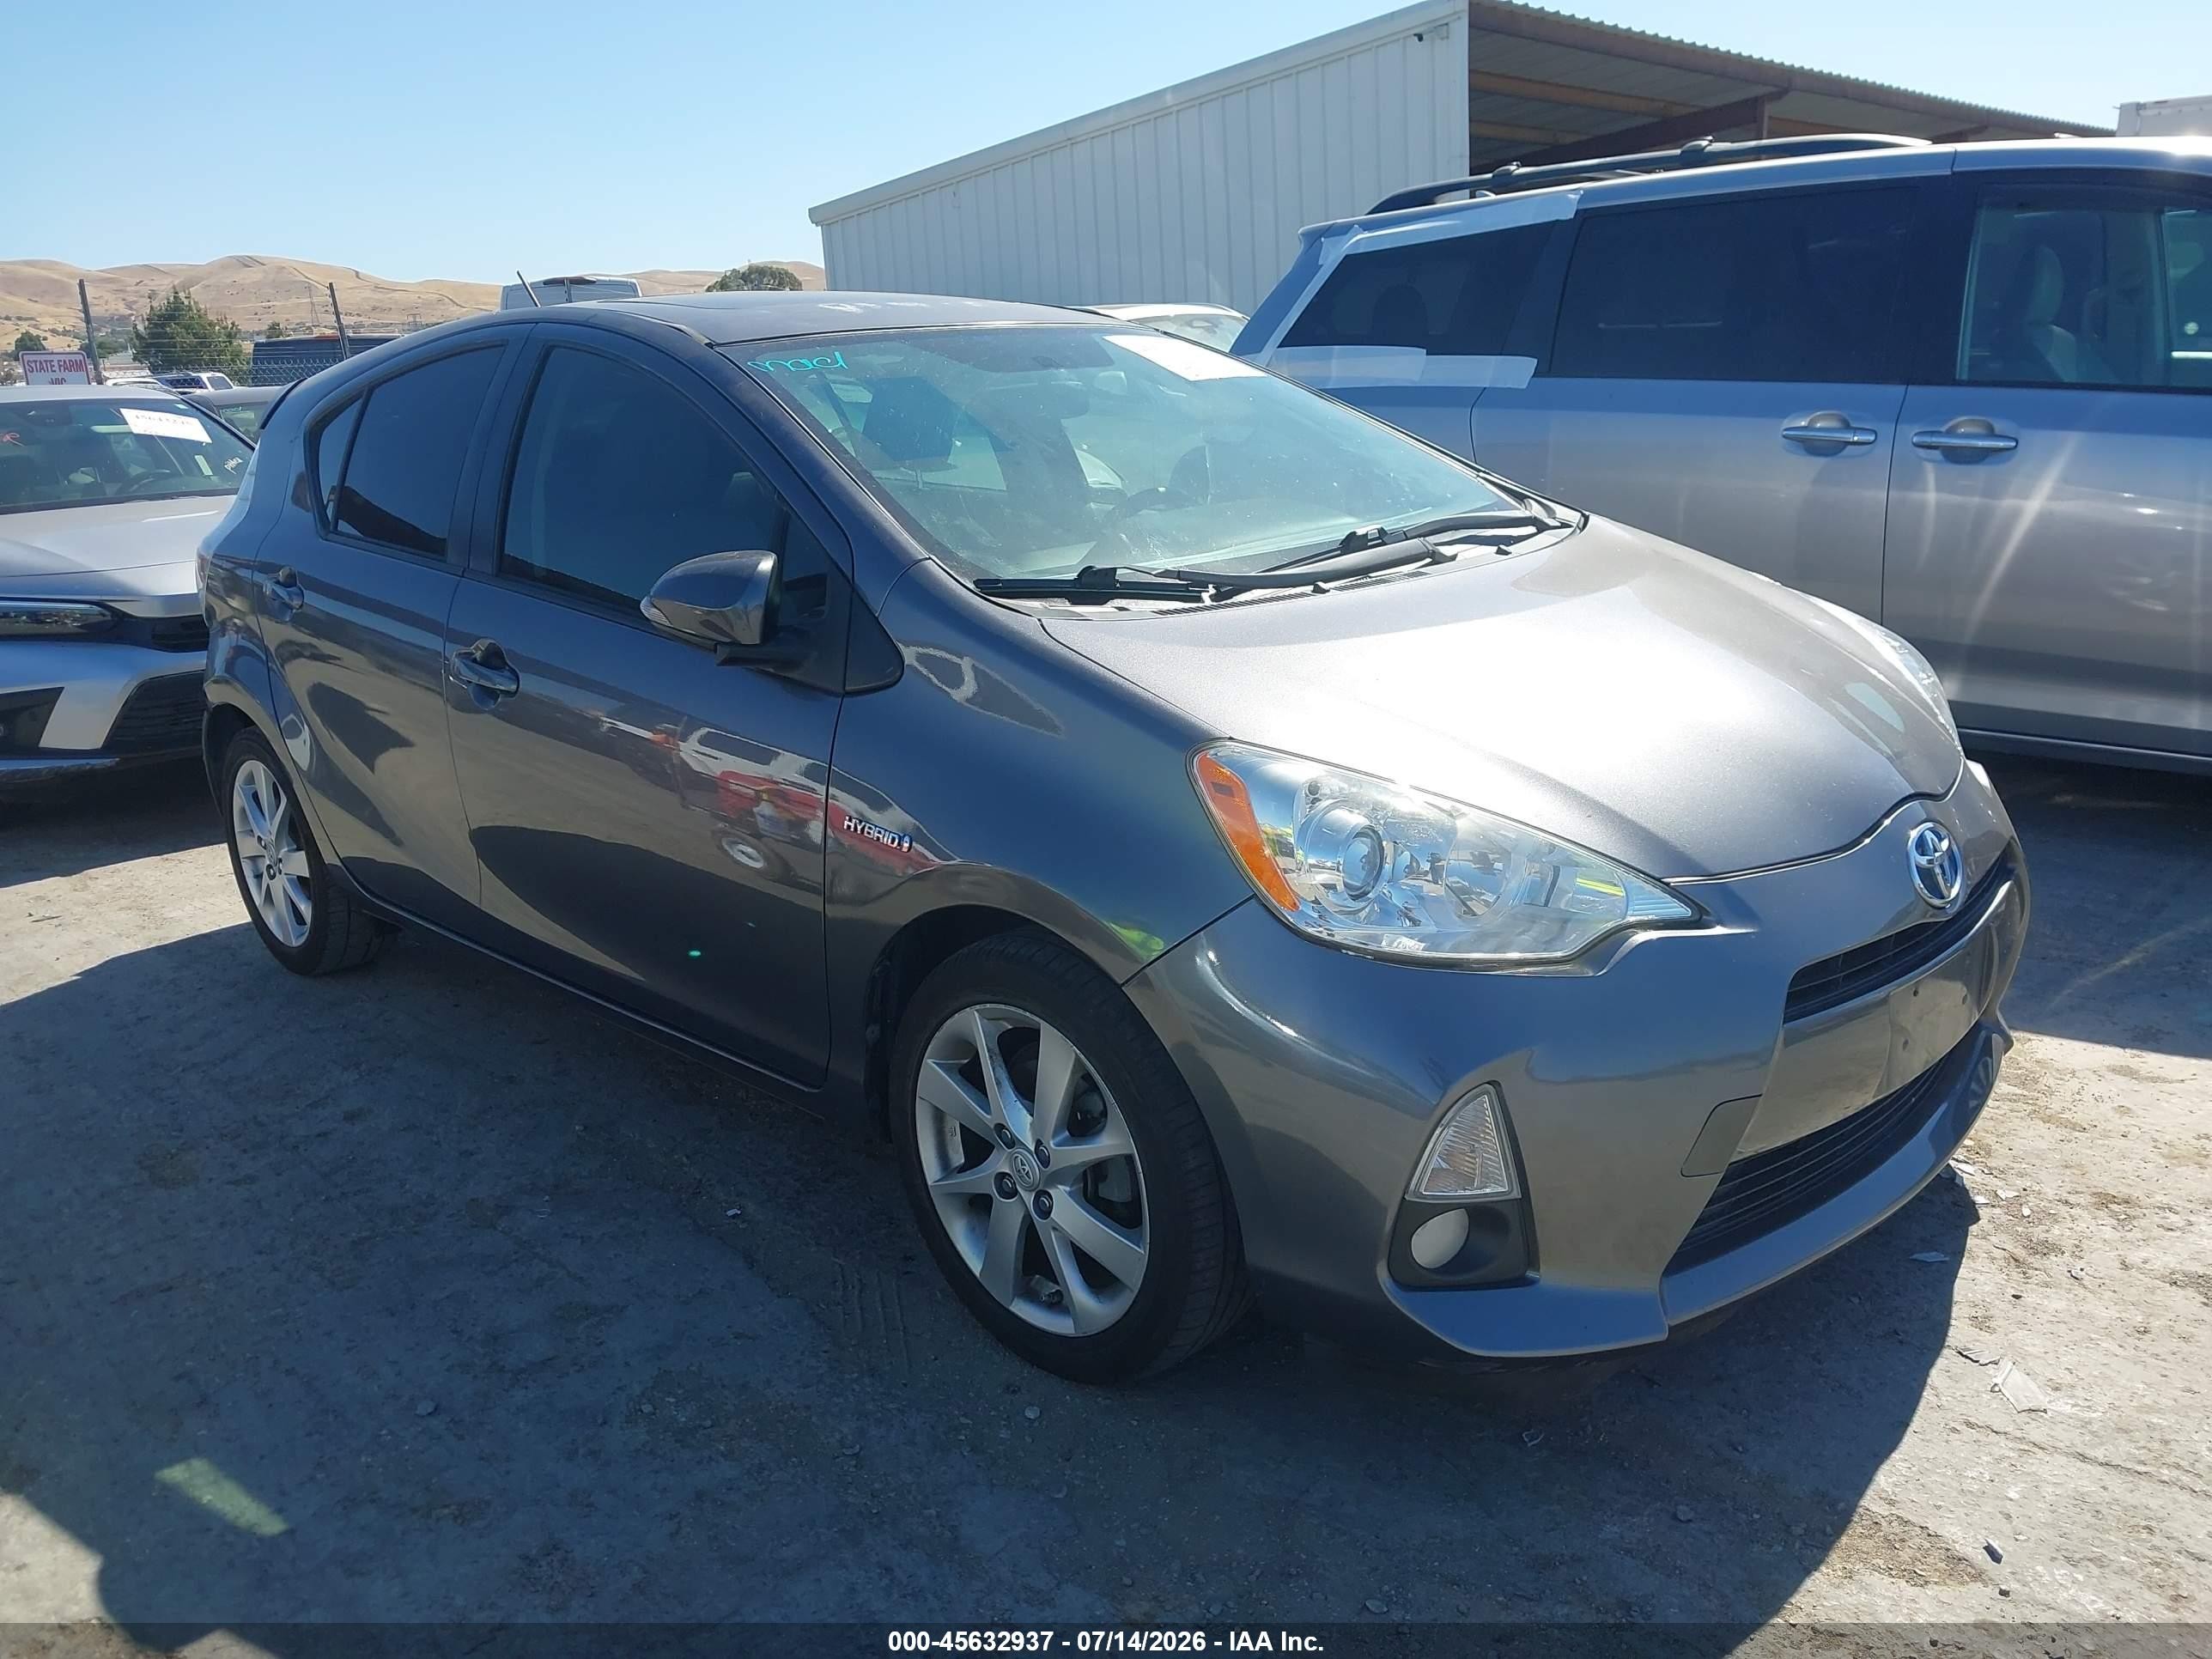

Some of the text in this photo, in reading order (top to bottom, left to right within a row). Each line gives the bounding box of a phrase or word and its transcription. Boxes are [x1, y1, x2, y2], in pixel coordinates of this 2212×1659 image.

[27, 358, 85, 374] STATE FARM
[843, 816, 898, 848] HYBRID
